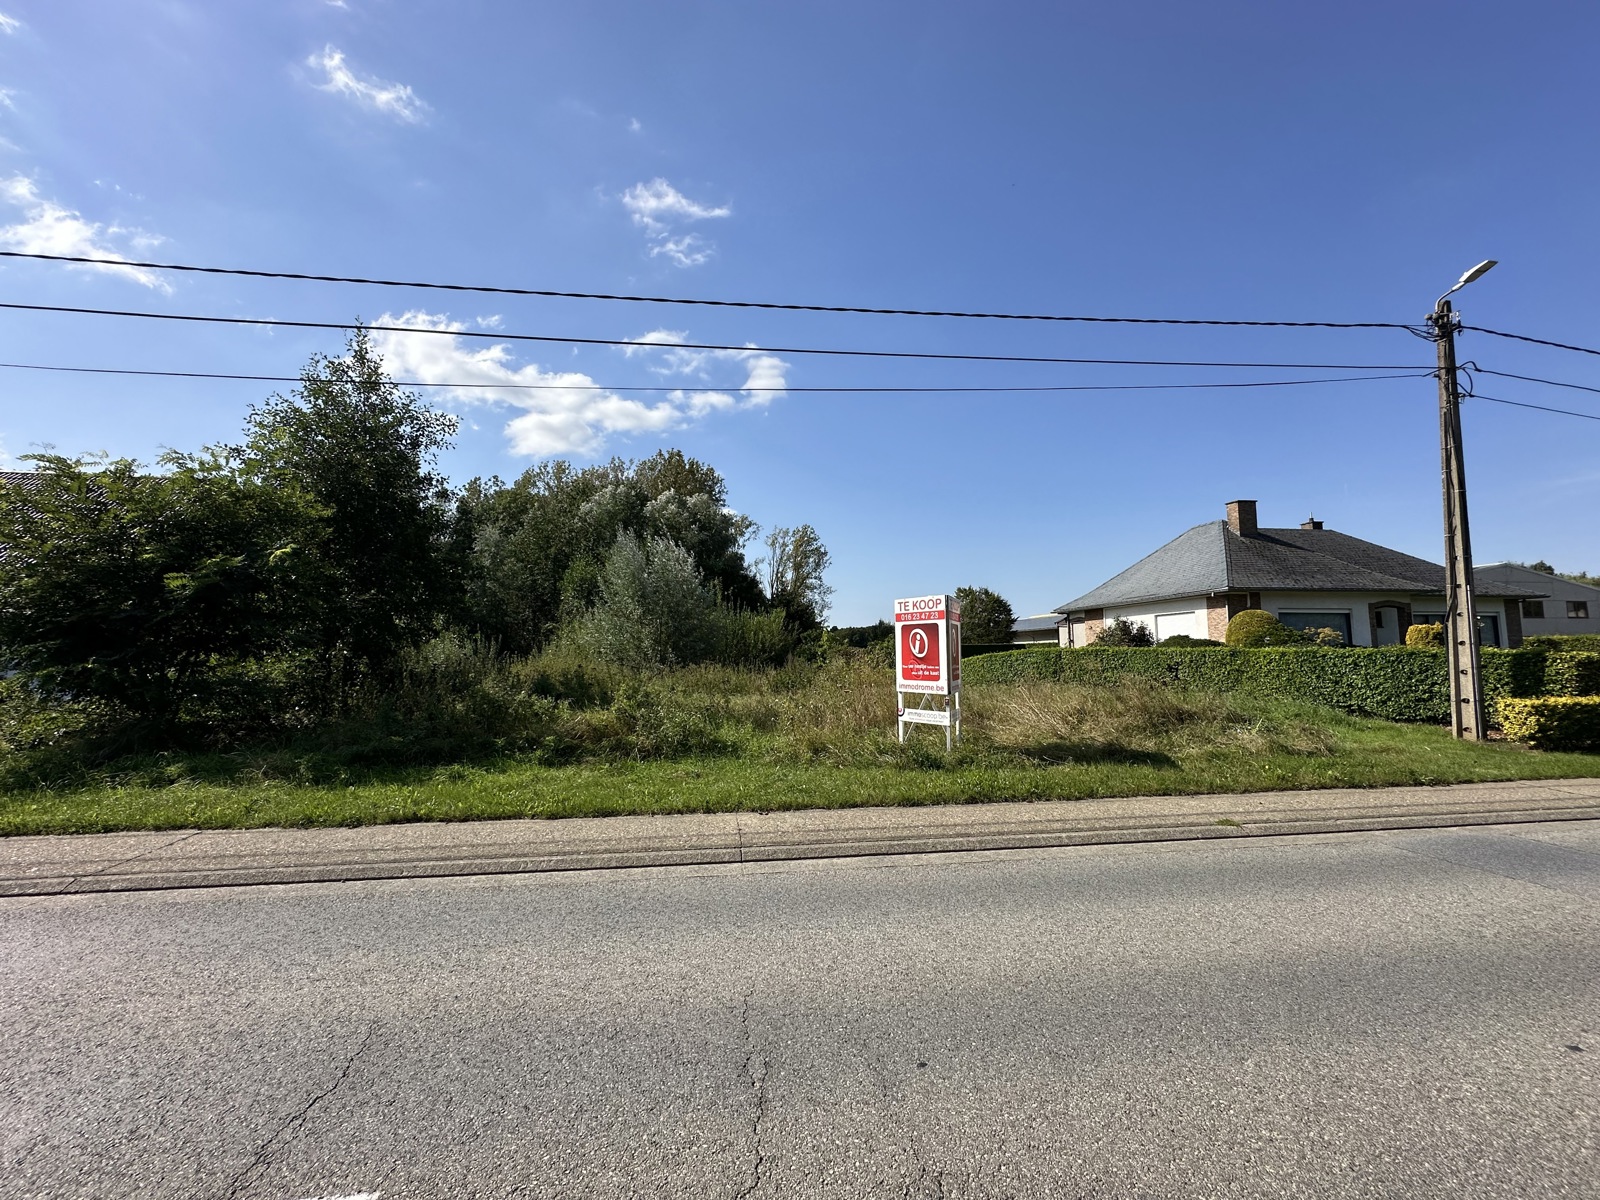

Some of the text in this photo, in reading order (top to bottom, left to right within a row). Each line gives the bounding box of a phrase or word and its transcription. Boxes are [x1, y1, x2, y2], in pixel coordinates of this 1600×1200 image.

[898, 601, 909, 611] TE
[912, 598, 942, 611] KOOP
[901, 613, 912, 621] 016
[921, 612, 930, 620] 47
[899, 683, 944, 692] immodrome.be
